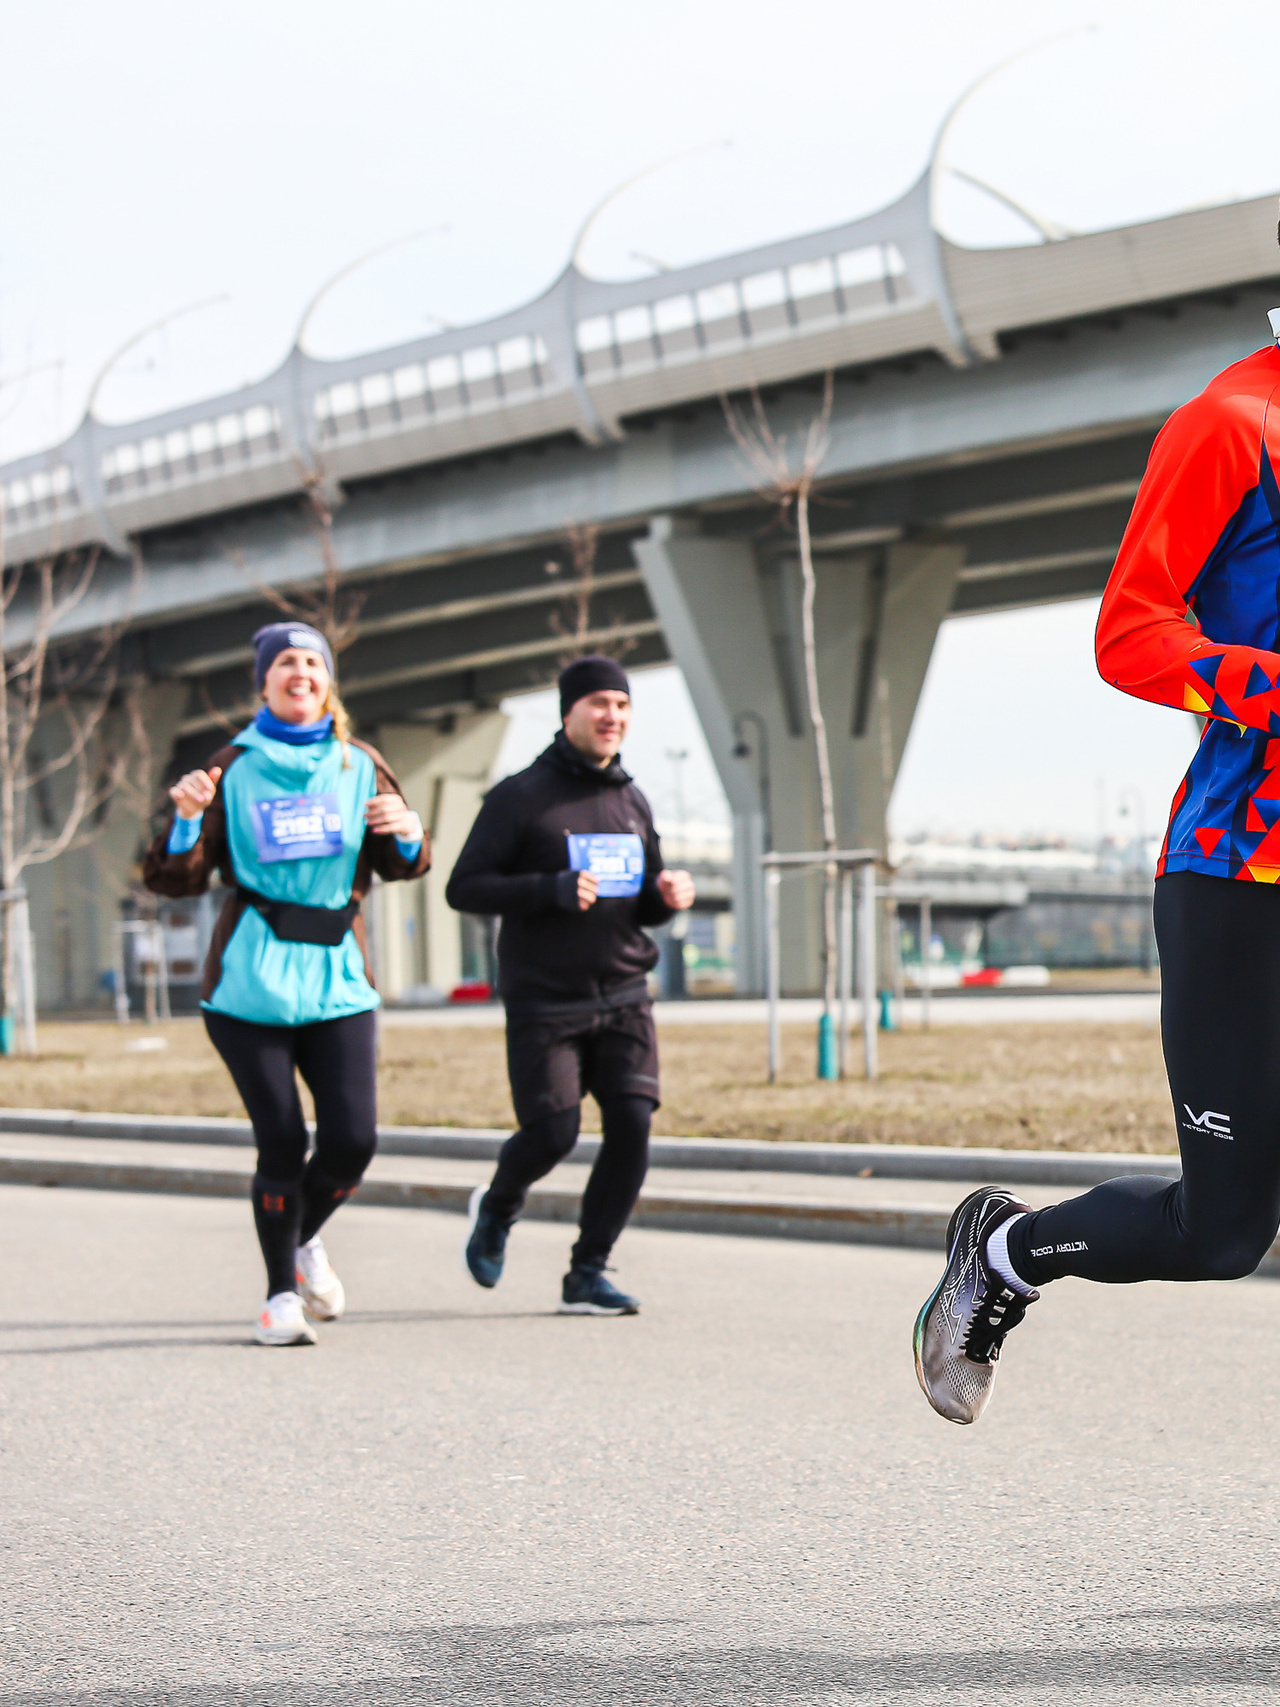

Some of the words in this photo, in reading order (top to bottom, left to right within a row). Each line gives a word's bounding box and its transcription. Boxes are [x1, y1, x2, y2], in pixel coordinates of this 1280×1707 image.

[1182, 1122, 1210, 1134] VICTORY
[1213, 1131, 1234, 1141] CODE
[1030, 1245, 1054, 1257] CODE
[1056, 1240, 1089, 1253] VICTORY
